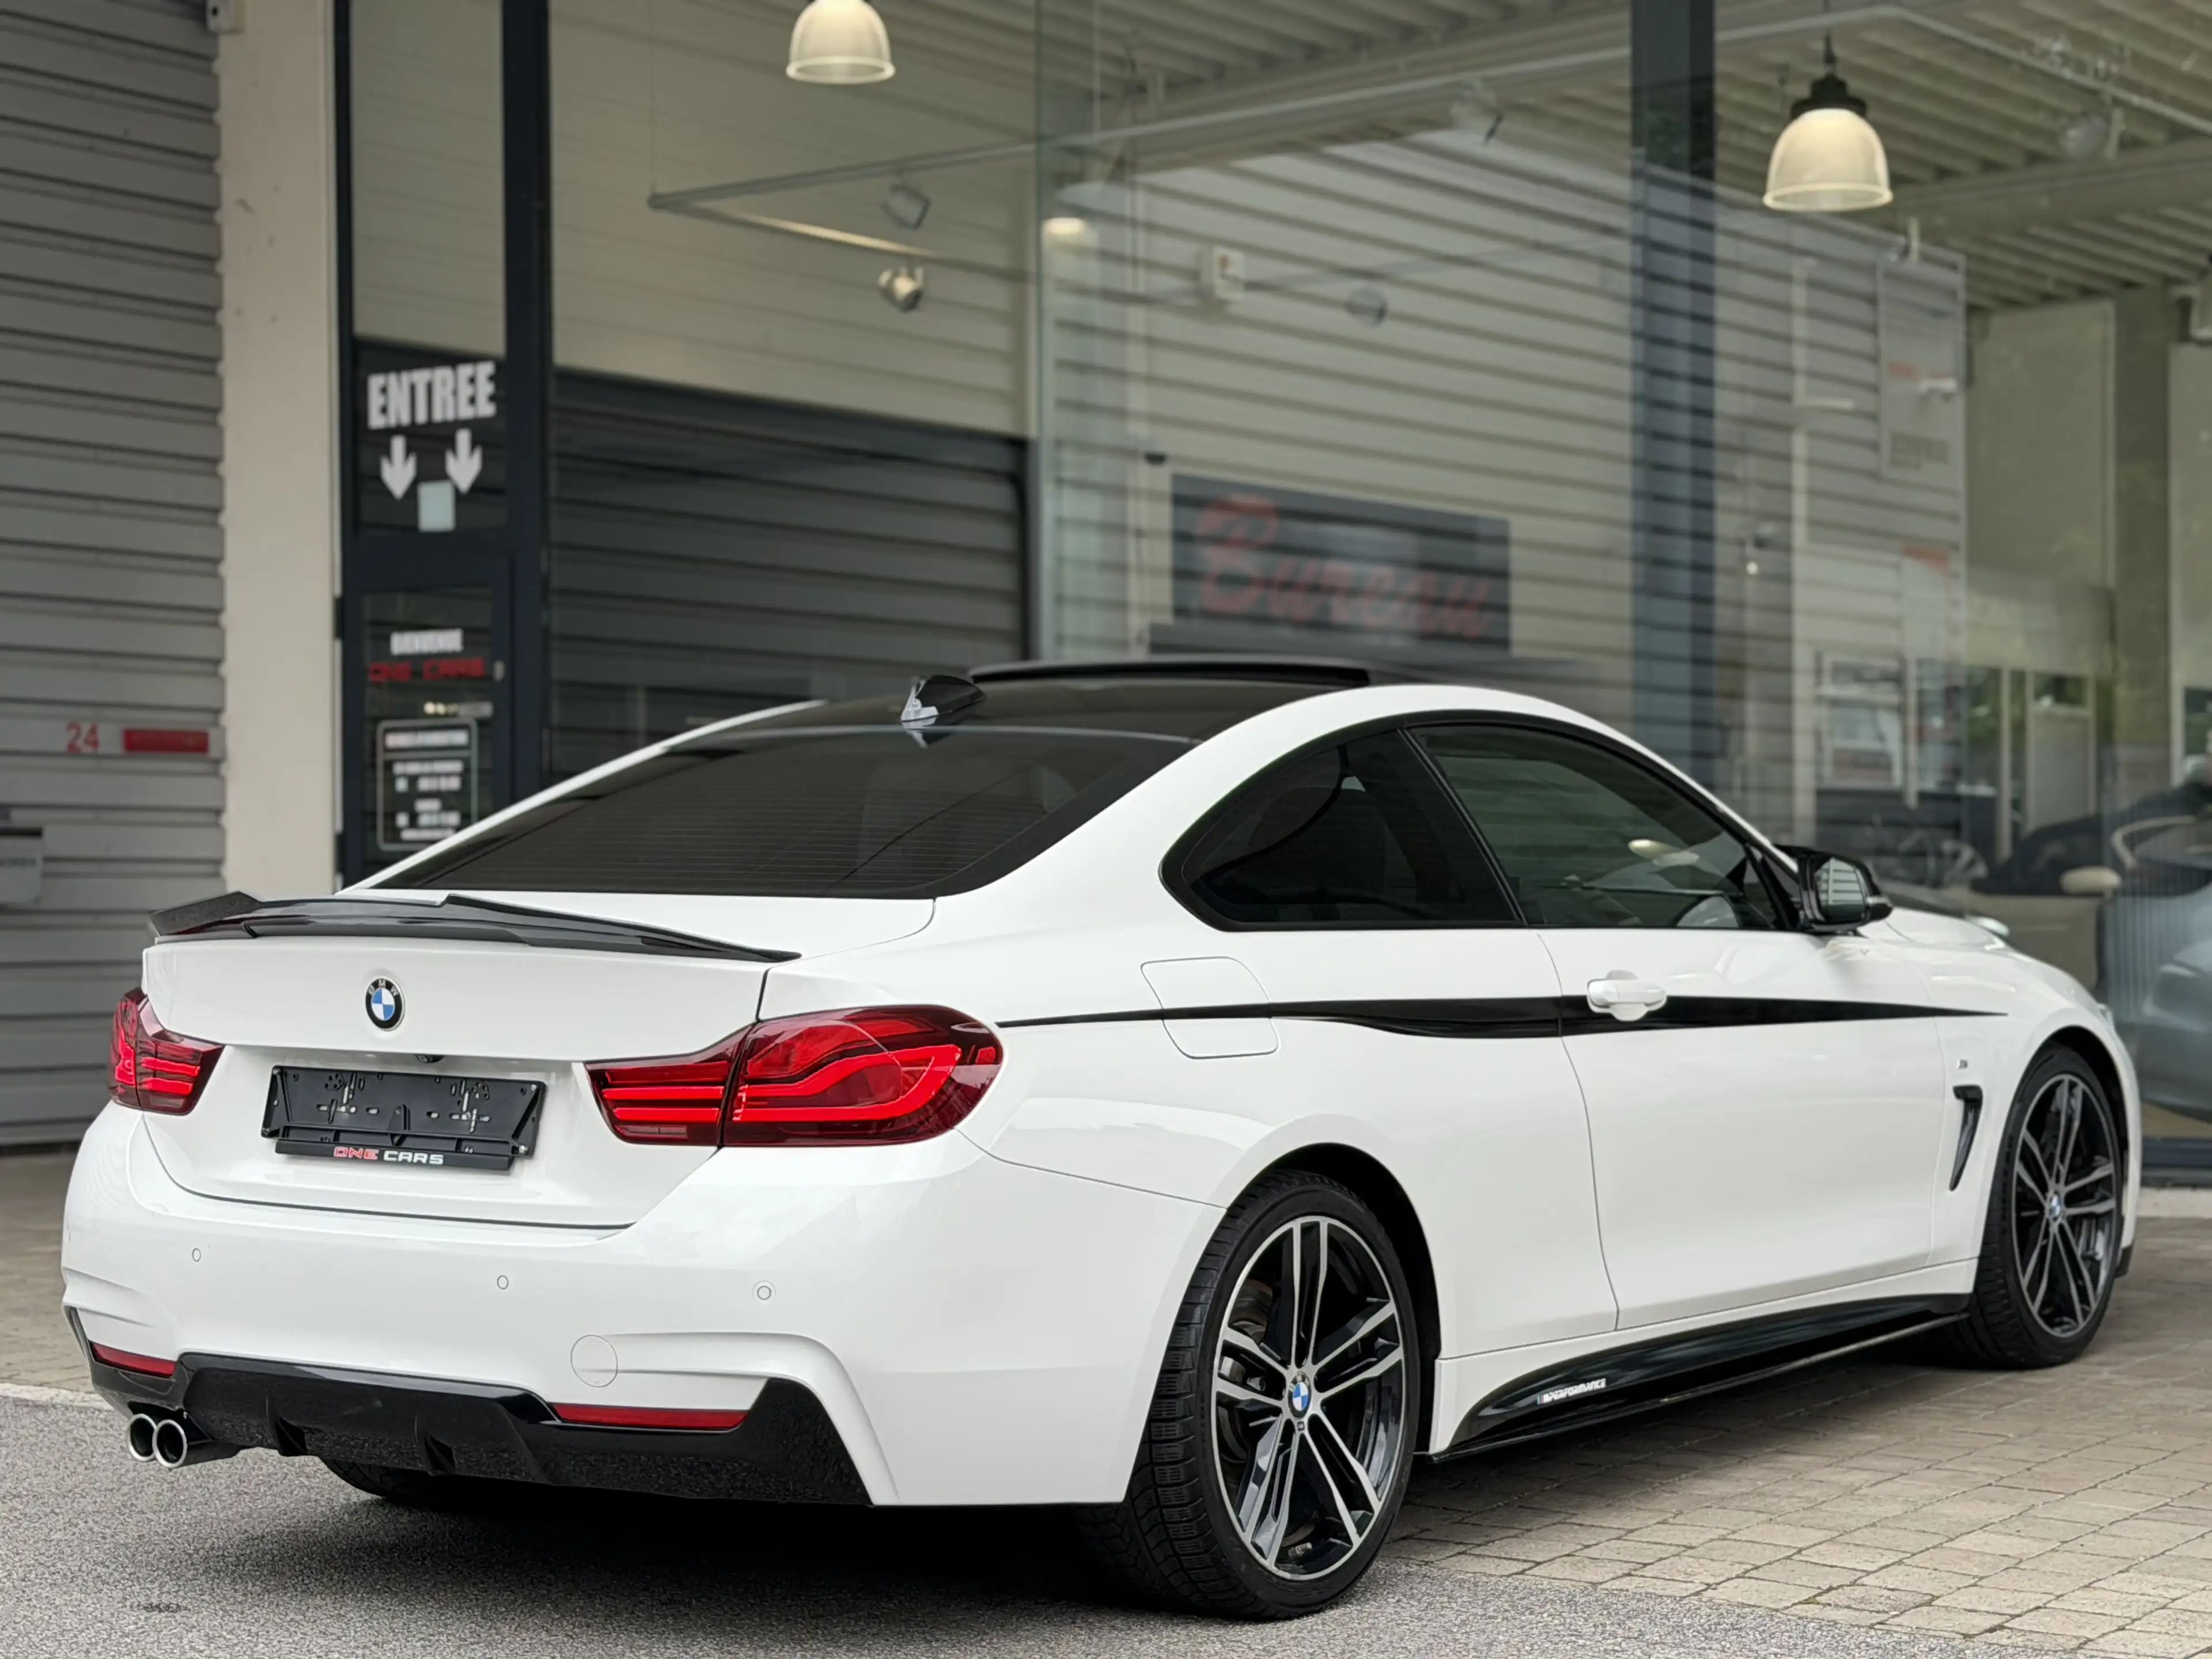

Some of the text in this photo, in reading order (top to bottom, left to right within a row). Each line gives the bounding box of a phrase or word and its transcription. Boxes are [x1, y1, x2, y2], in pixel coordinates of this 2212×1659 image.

[367, 360, 497, 430] ENTREE
[1194, 494, 1493, 639] Bureau
[65, 720, 100, 753] 24
[368, 978, 399, 996] BMW
[334, 1146, 444, 1165] ONE CARS
